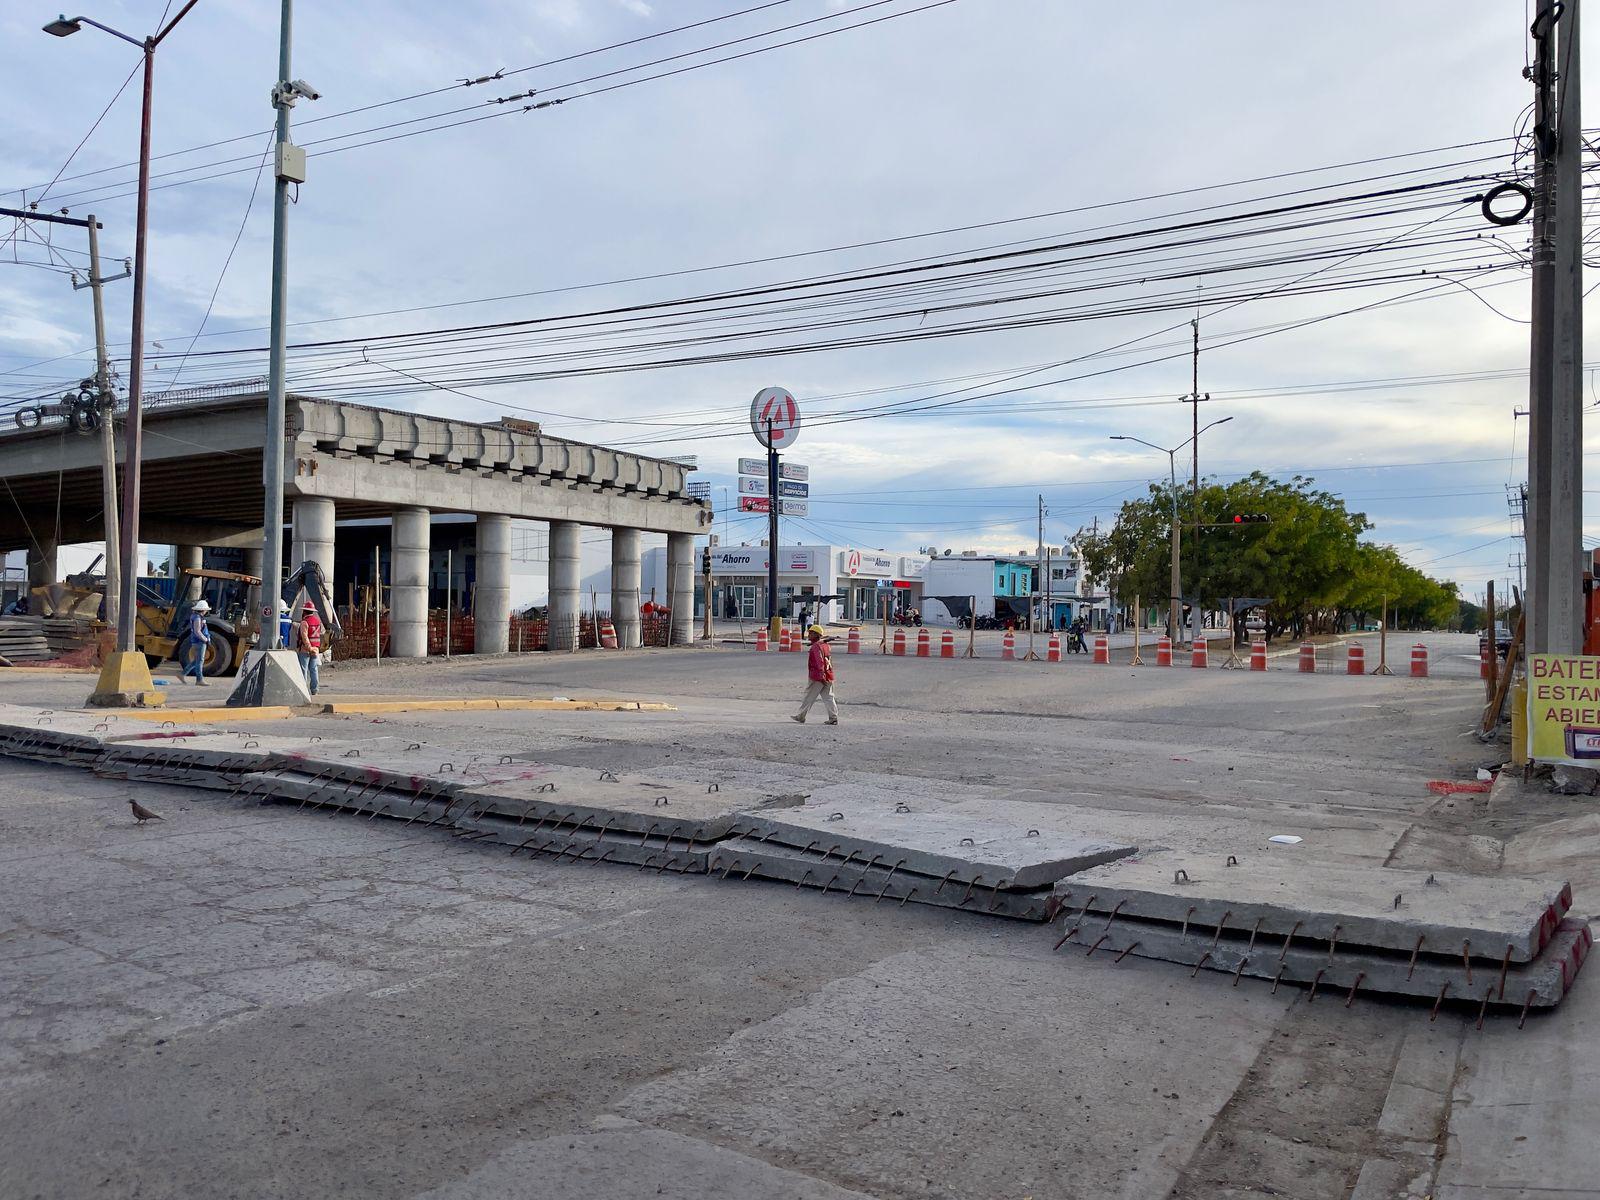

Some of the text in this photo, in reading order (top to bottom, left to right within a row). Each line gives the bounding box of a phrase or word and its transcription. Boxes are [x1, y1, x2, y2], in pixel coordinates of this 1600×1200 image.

[722, 554, 750, 564] Ahorro
[874, 557, 891, 568] Ahorro
[1545, 707, 1600, 724] ABIE
